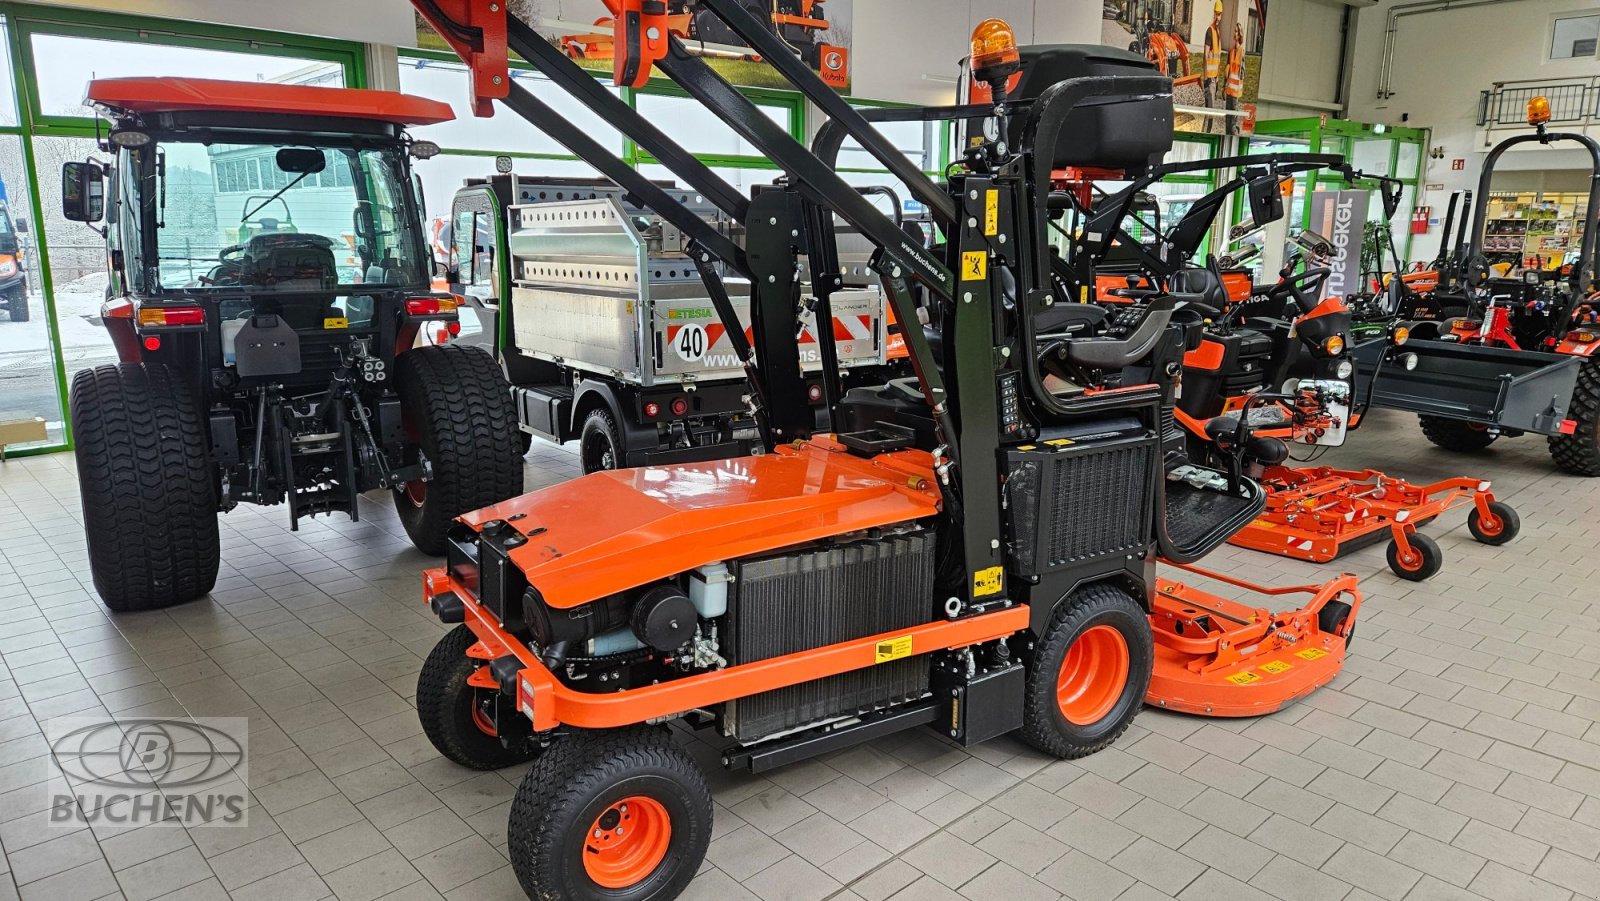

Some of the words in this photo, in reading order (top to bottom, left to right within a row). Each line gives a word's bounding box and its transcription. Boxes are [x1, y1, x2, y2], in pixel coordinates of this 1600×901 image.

[901, 241, 946, 282] www.buchens.de
[675, 308, 713, 319] ETESIA
[681, 327, 703, 358] 40
